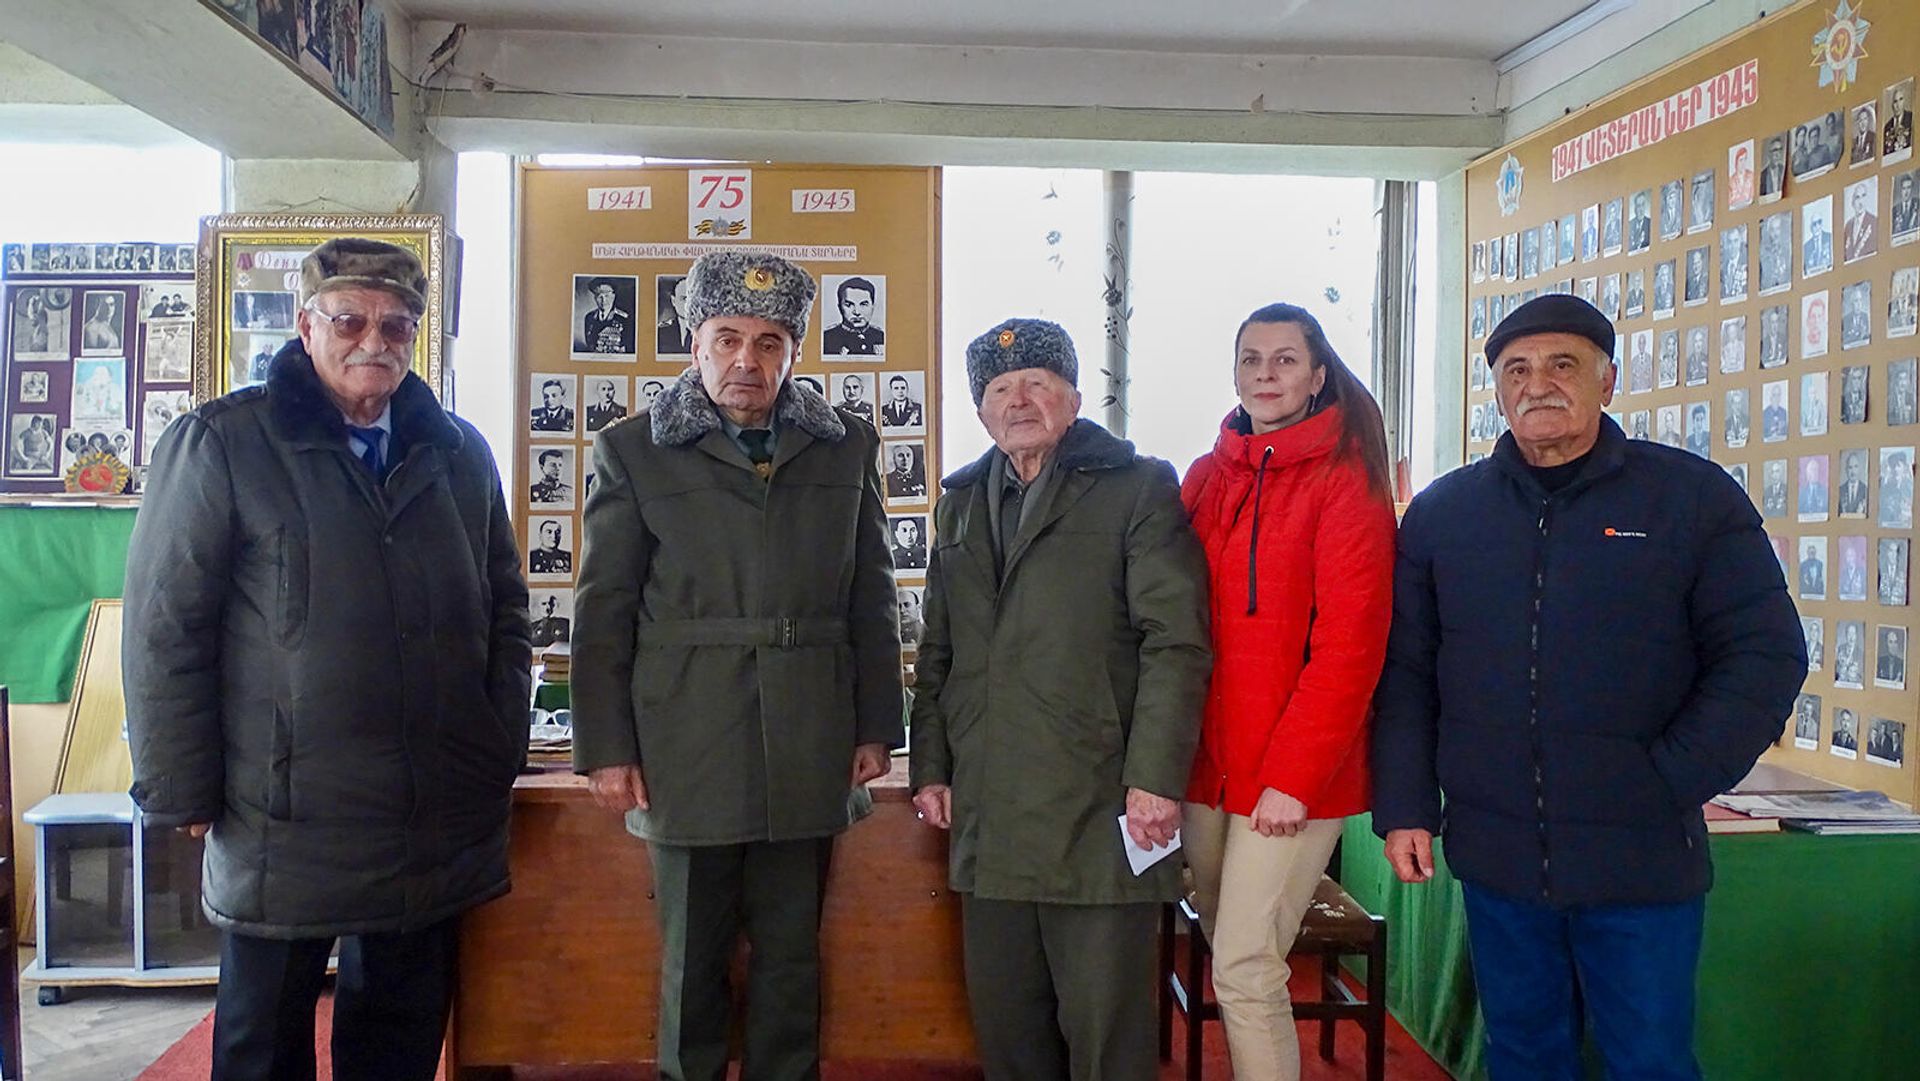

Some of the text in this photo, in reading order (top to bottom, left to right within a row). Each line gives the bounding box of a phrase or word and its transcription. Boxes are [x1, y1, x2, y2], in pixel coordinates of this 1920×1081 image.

[1552, 137, 1583, 180] 1941
[1707, 61, 1758, 119] 1945
[598, 190, 646, 209] 1941
[696, 176, 746, 209] 75
[801, 190, 851, 210] 1945
